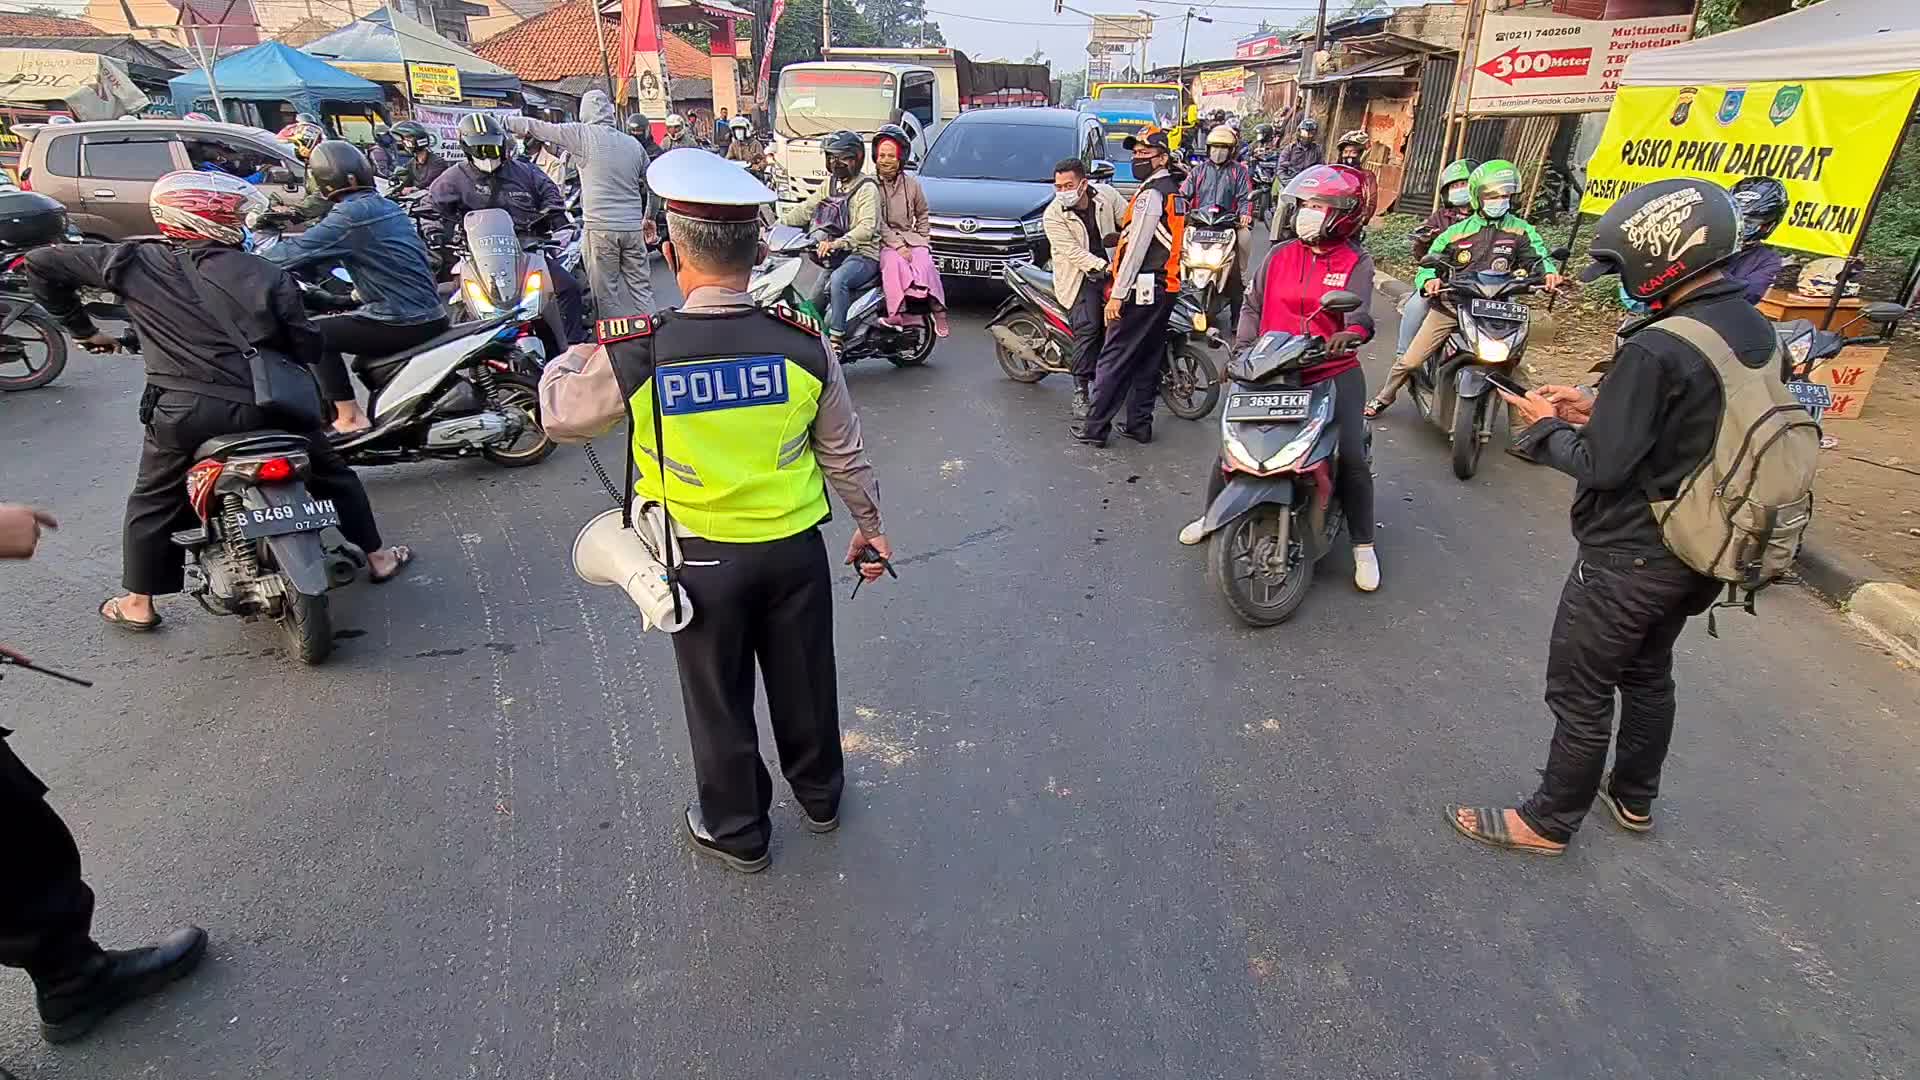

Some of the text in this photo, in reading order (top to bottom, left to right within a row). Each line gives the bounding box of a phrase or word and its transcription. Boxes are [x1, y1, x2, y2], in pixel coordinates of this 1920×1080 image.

[1505, 26, 1582, 40] (021) 7402608
[1612, 23, 1688, 37] Multimedia
[1493, 52, 1590, 78] 300 Meter
[1532, 96, 1561, 105] Pondok
[1621, 139, 1833, 181] POSKO PPKM DARURAT
[812, 169, 831, 177] ISU
[1788, 200, 1861, 234] SELATAN
[951, 258, 970, 270] 1373
[975, 259, 990, 271] UIP
[1638, 260, 1687, 295] KAHFI
[1832, 366, 1864, 386] Vit
[662, 364, 784, 408] POLISI
[1232, 397, 1241, 408] B
[1249, 395, 1280, 407] 3693
[236, 499, 336, 527] B 6469 WVH
[295, 517, 337, 530] 07-24
